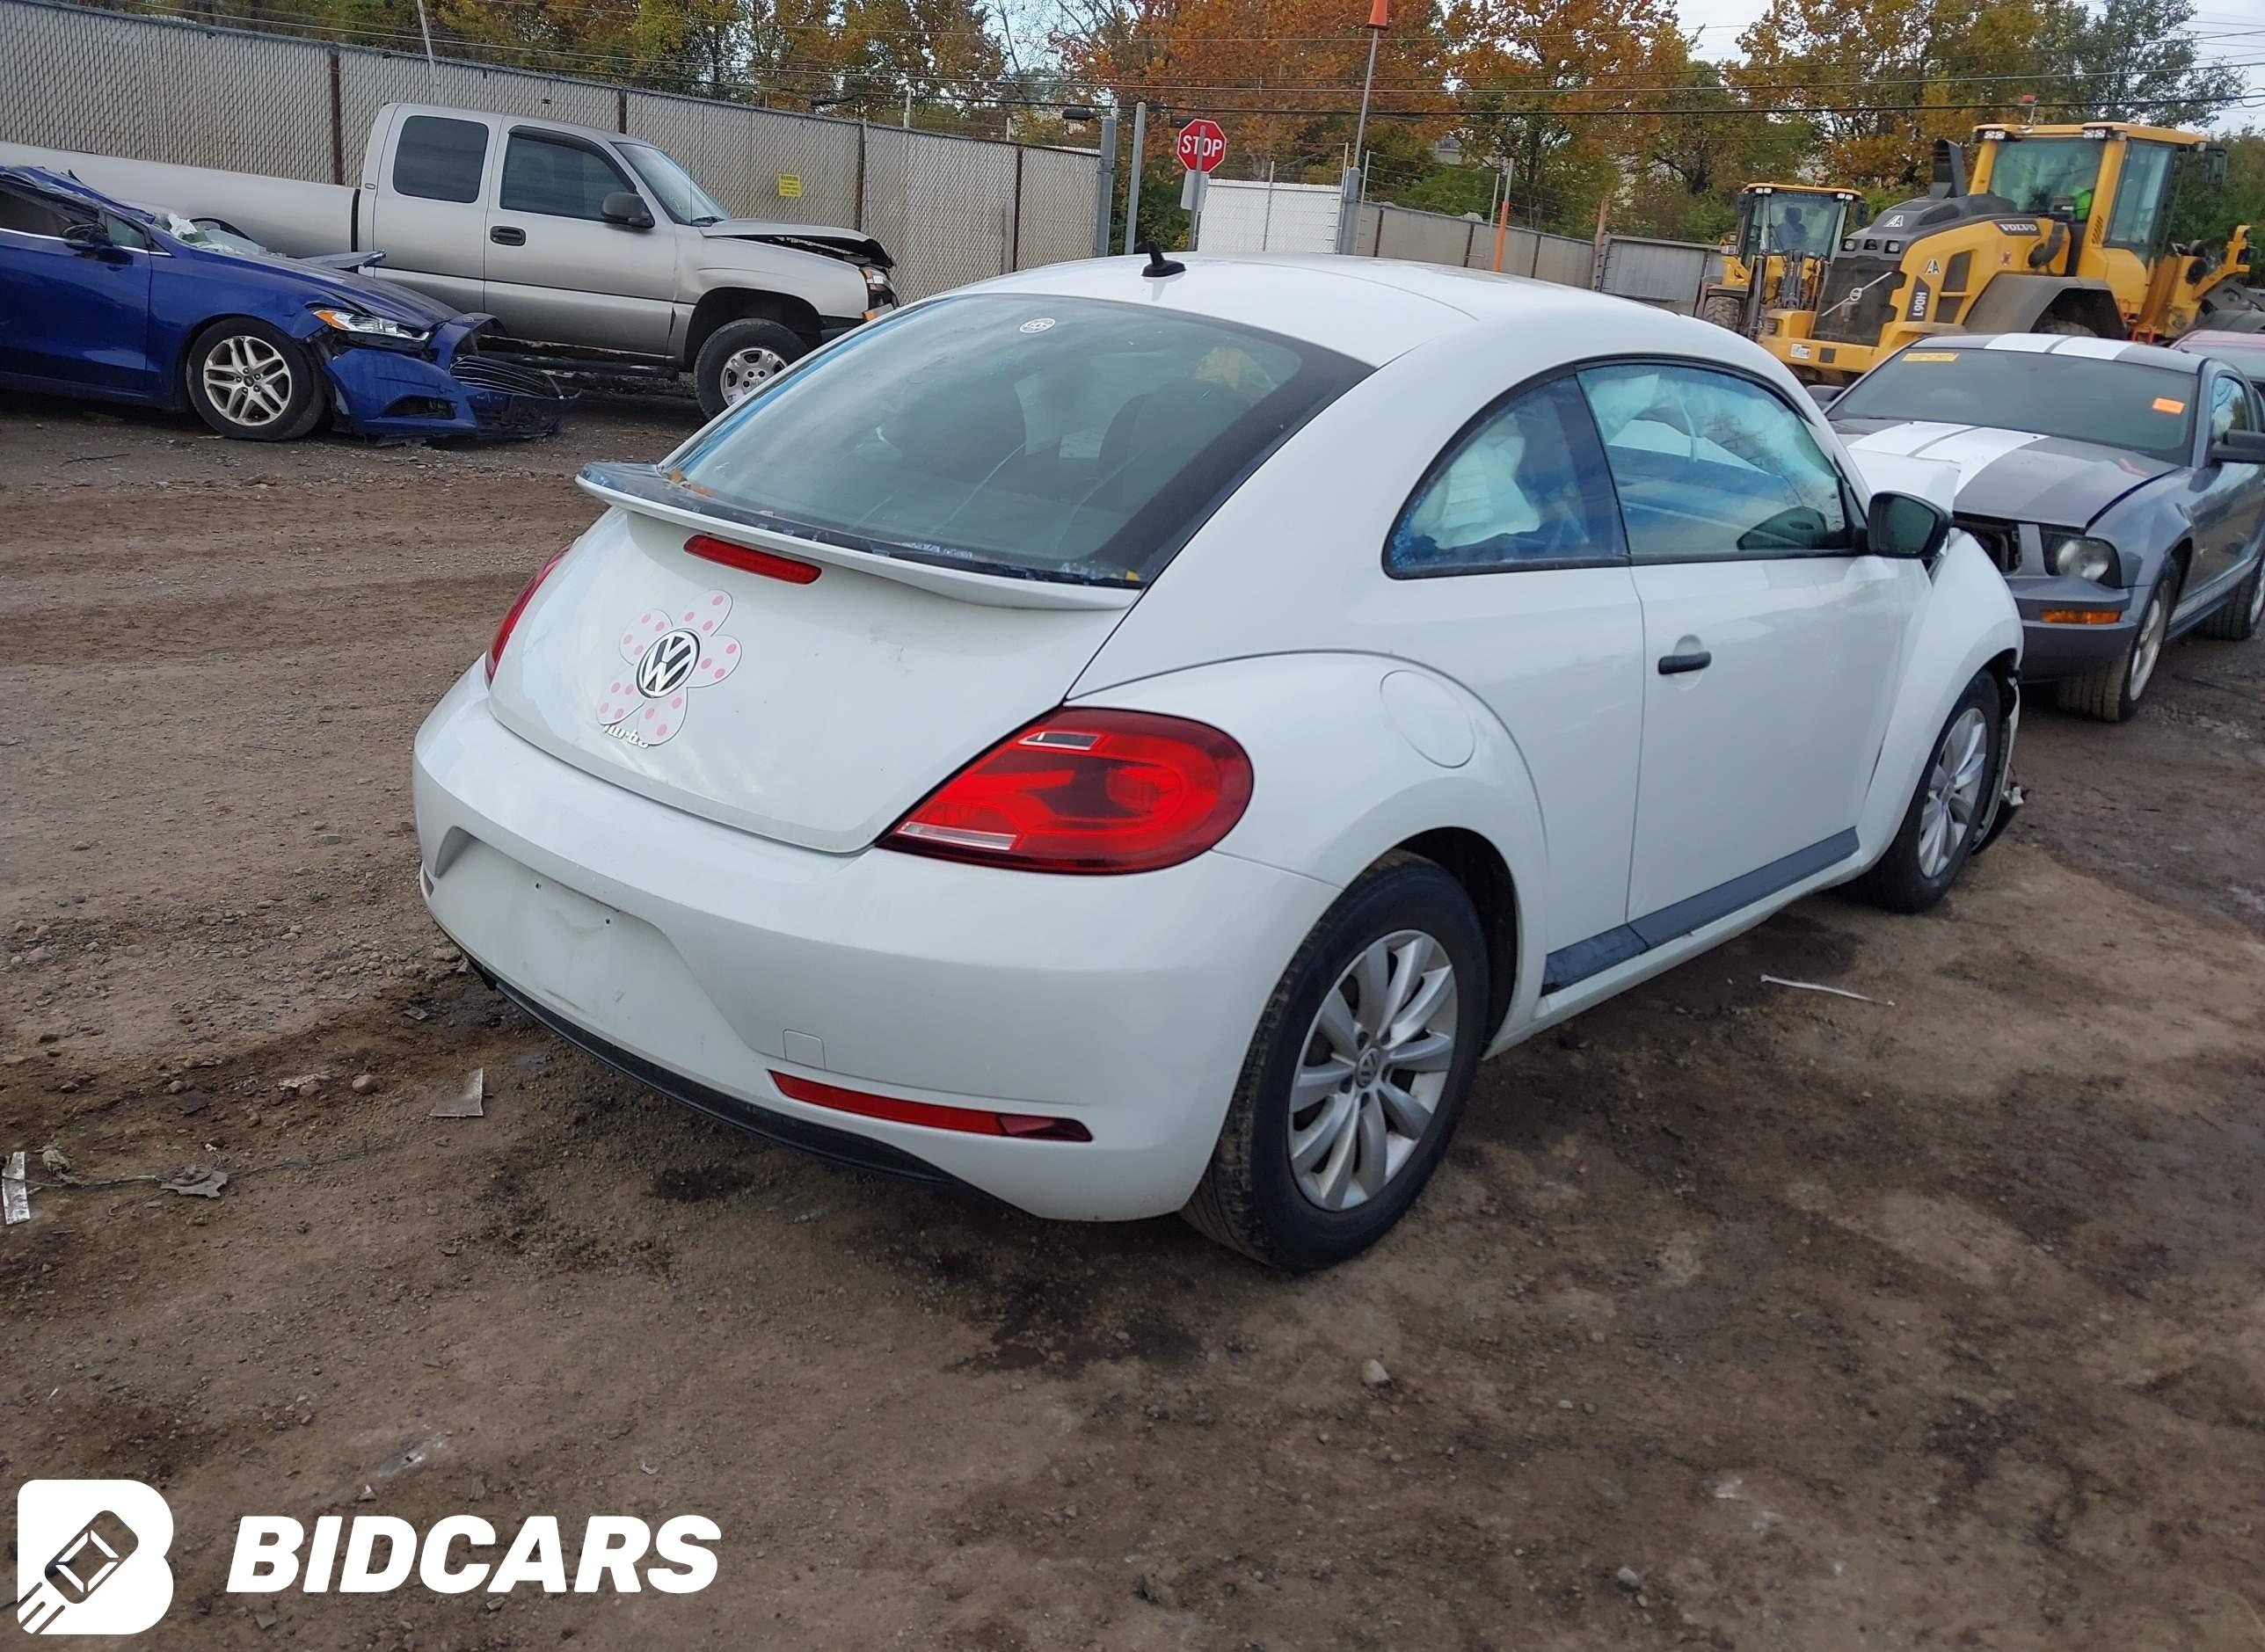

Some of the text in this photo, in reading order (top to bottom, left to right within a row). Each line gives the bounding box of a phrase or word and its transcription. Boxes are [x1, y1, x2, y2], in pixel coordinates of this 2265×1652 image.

[1181, 135, 1223, 157] STOP
[1999, 223, 2037, 232] VOLVO
[1912, 292, 1927, 317] L90H
[640, 631, 696, 696] VW
